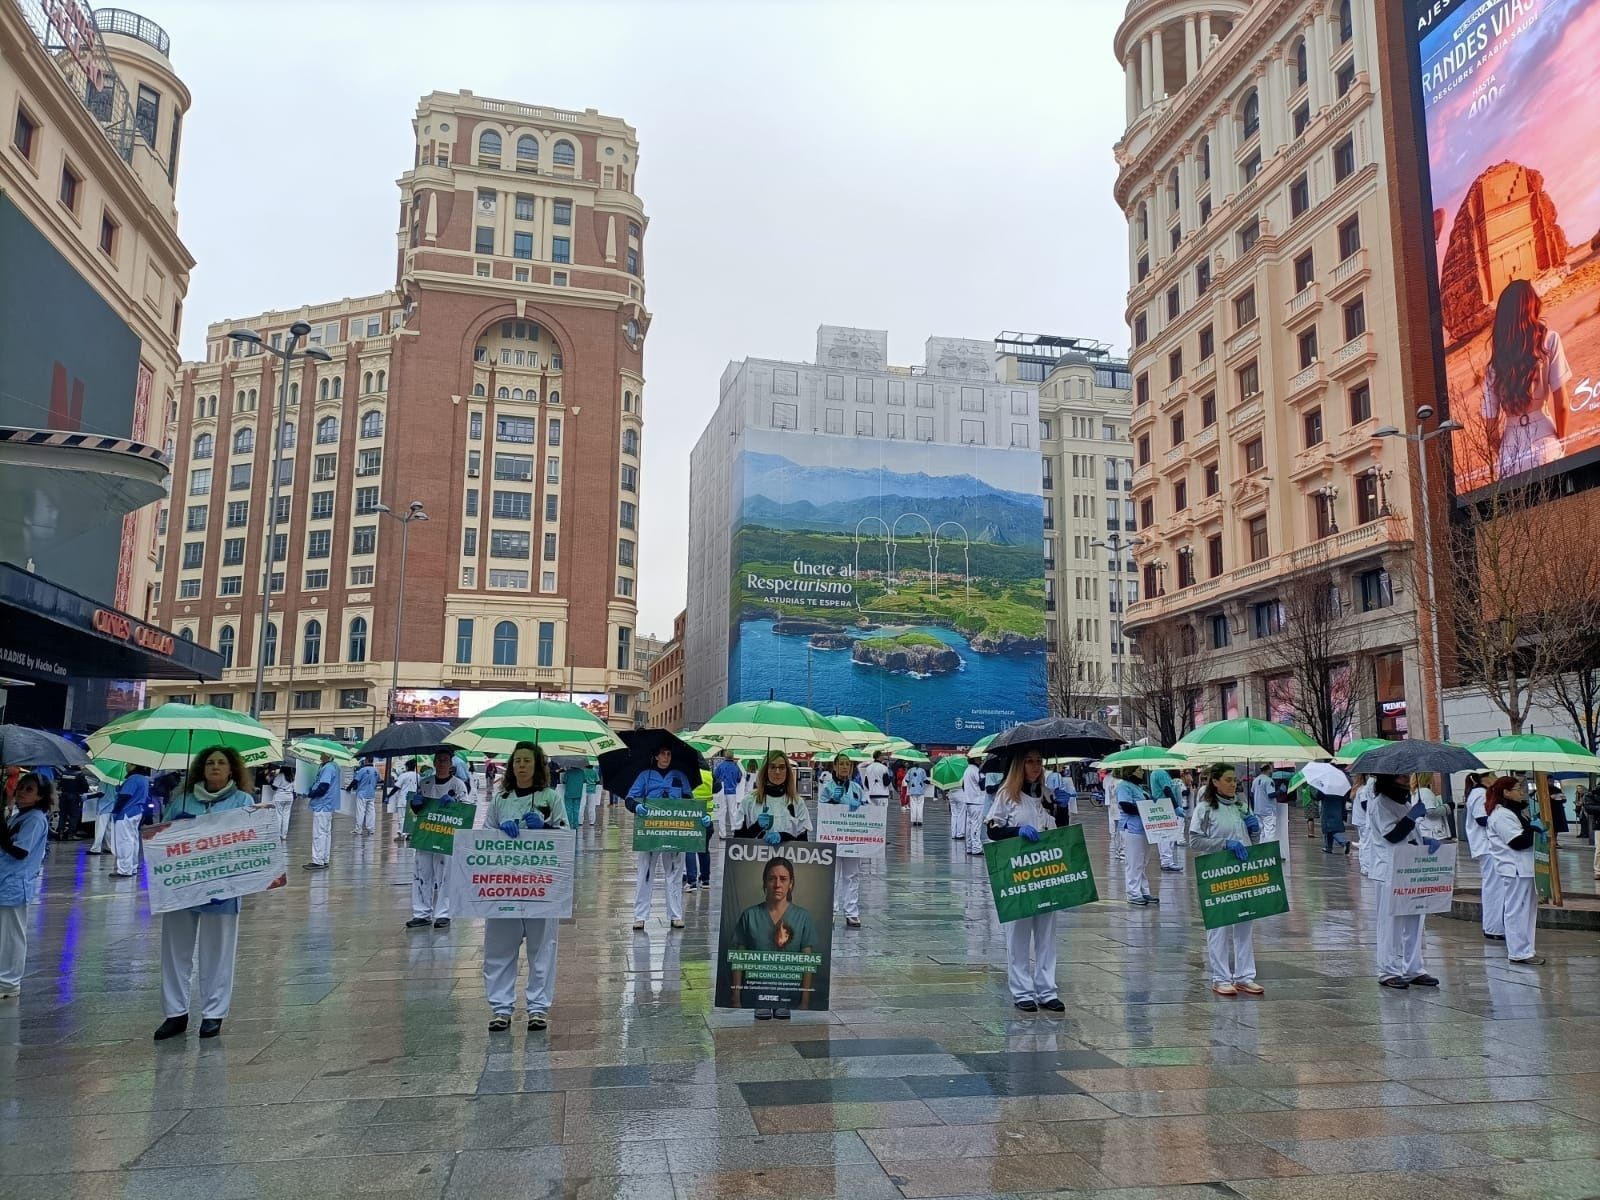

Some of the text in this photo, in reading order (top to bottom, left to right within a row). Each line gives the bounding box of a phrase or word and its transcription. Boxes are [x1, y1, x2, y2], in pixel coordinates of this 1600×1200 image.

[1422, 23, 1488, 96] RANDES
[1433, 66, 1473, 104] DESCUBRE
[1476, 38, 1508, 68] ARABIA
[1472, 74, 1496, 98] HASTA
[793, 557, 852, 577] Únete al
[747, 574, 852, 594] Respeturismo
[763, 596, 852, 607] ASTURIAS TE ESPERA
[92, 609, 176, 656] CINES CALLAO
[26, 655, 35, 670] by
[35, 658, 53, 672] Nacho
[54, 662, 67, 676] Cano
[427, 812, 463, 826] ESTAMOS
[645, 809, 703, 818] UANDO FALTAN
[644, 820, 694, 828] ENFERMERAS
[166, 828, 257, 857] ME QUEMA
[475, 840, 555, 851] URGENCIAS
[154, 842, 277, 875] NO SABER MI TURNO
[728, 844, 833, 866] QUEMADAS
[1010, 848, 1063, 869] MADRID
[1013, 862, 1068, 882] NO CUIDA
[1201, 857, 1276, 879] CUANDO FALTAN
[164, 874, 192, 886] CON
[472, 874, 553, 884] ENFERMERAS
[1000, 871, 1088, 898] A SUS ENFERMERAS
[1210, 872, 1270, 893] ENFERMERAS
[478, 887, 545, 897] AGOTADAS
[1205, 884, 1281, 907] EL PACIENTE ESPERA
[1393, 885, 1452, 896] FALTAN ENFERMERAS
[728, 952, 822, 963] FALTAN ENFERMERAS
